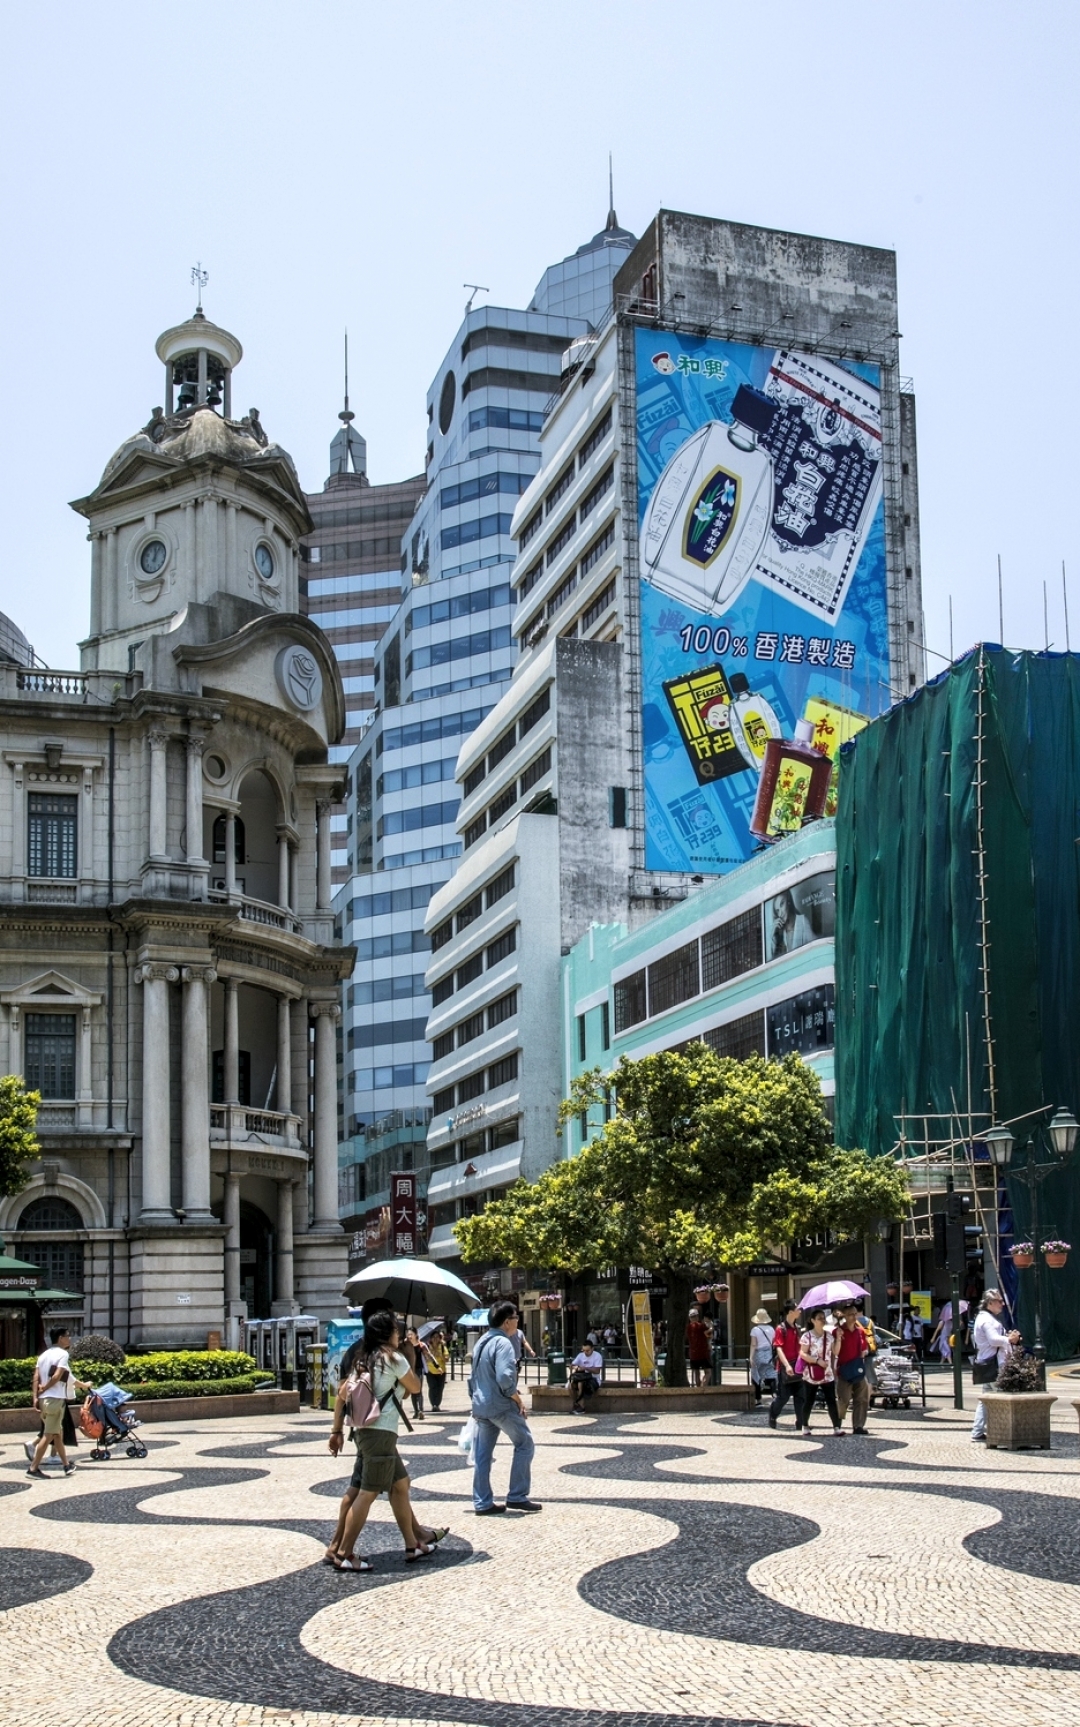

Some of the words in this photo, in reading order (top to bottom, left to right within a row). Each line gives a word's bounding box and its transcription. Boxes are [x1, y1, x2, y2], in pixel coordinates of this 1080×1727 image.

[677, 355, 726, 380] 和興
[799, 440, 836, 473] 和興
[774, 460, 827, 538] 白花油
[703, 511, 728, 555] 和興白花油
[681, 625, 747, 656] 100%
[755, 632, 855, 669] 香港製造
[775, 1021, 799, 1040] TSL
[396, 1179, 414, 1252] 周大福
